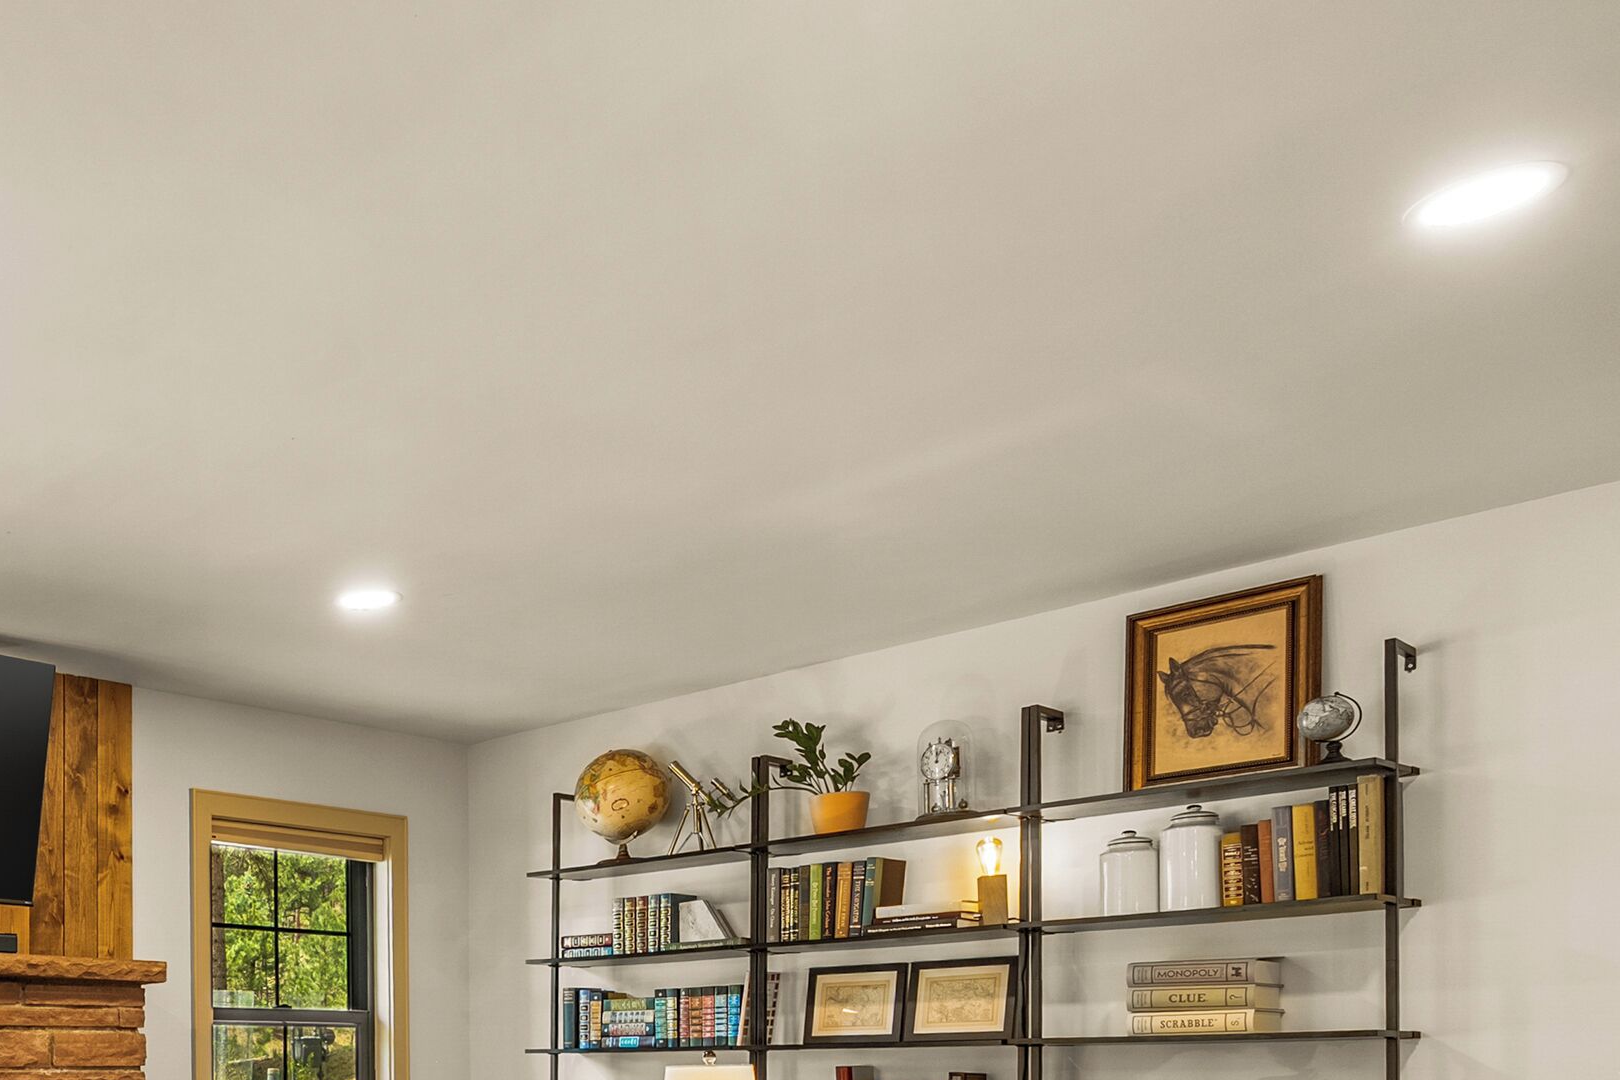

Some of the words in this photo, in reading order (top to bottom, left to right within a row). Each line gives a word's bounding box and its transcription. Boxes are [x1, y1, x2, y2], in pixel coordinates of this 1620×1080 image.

[1156, 968, 1219, 979] MONOPOLY
[1168, 993, 1207, 1003] CLUE
[1160, 1018, 1214, 1029] SCRABBLE
